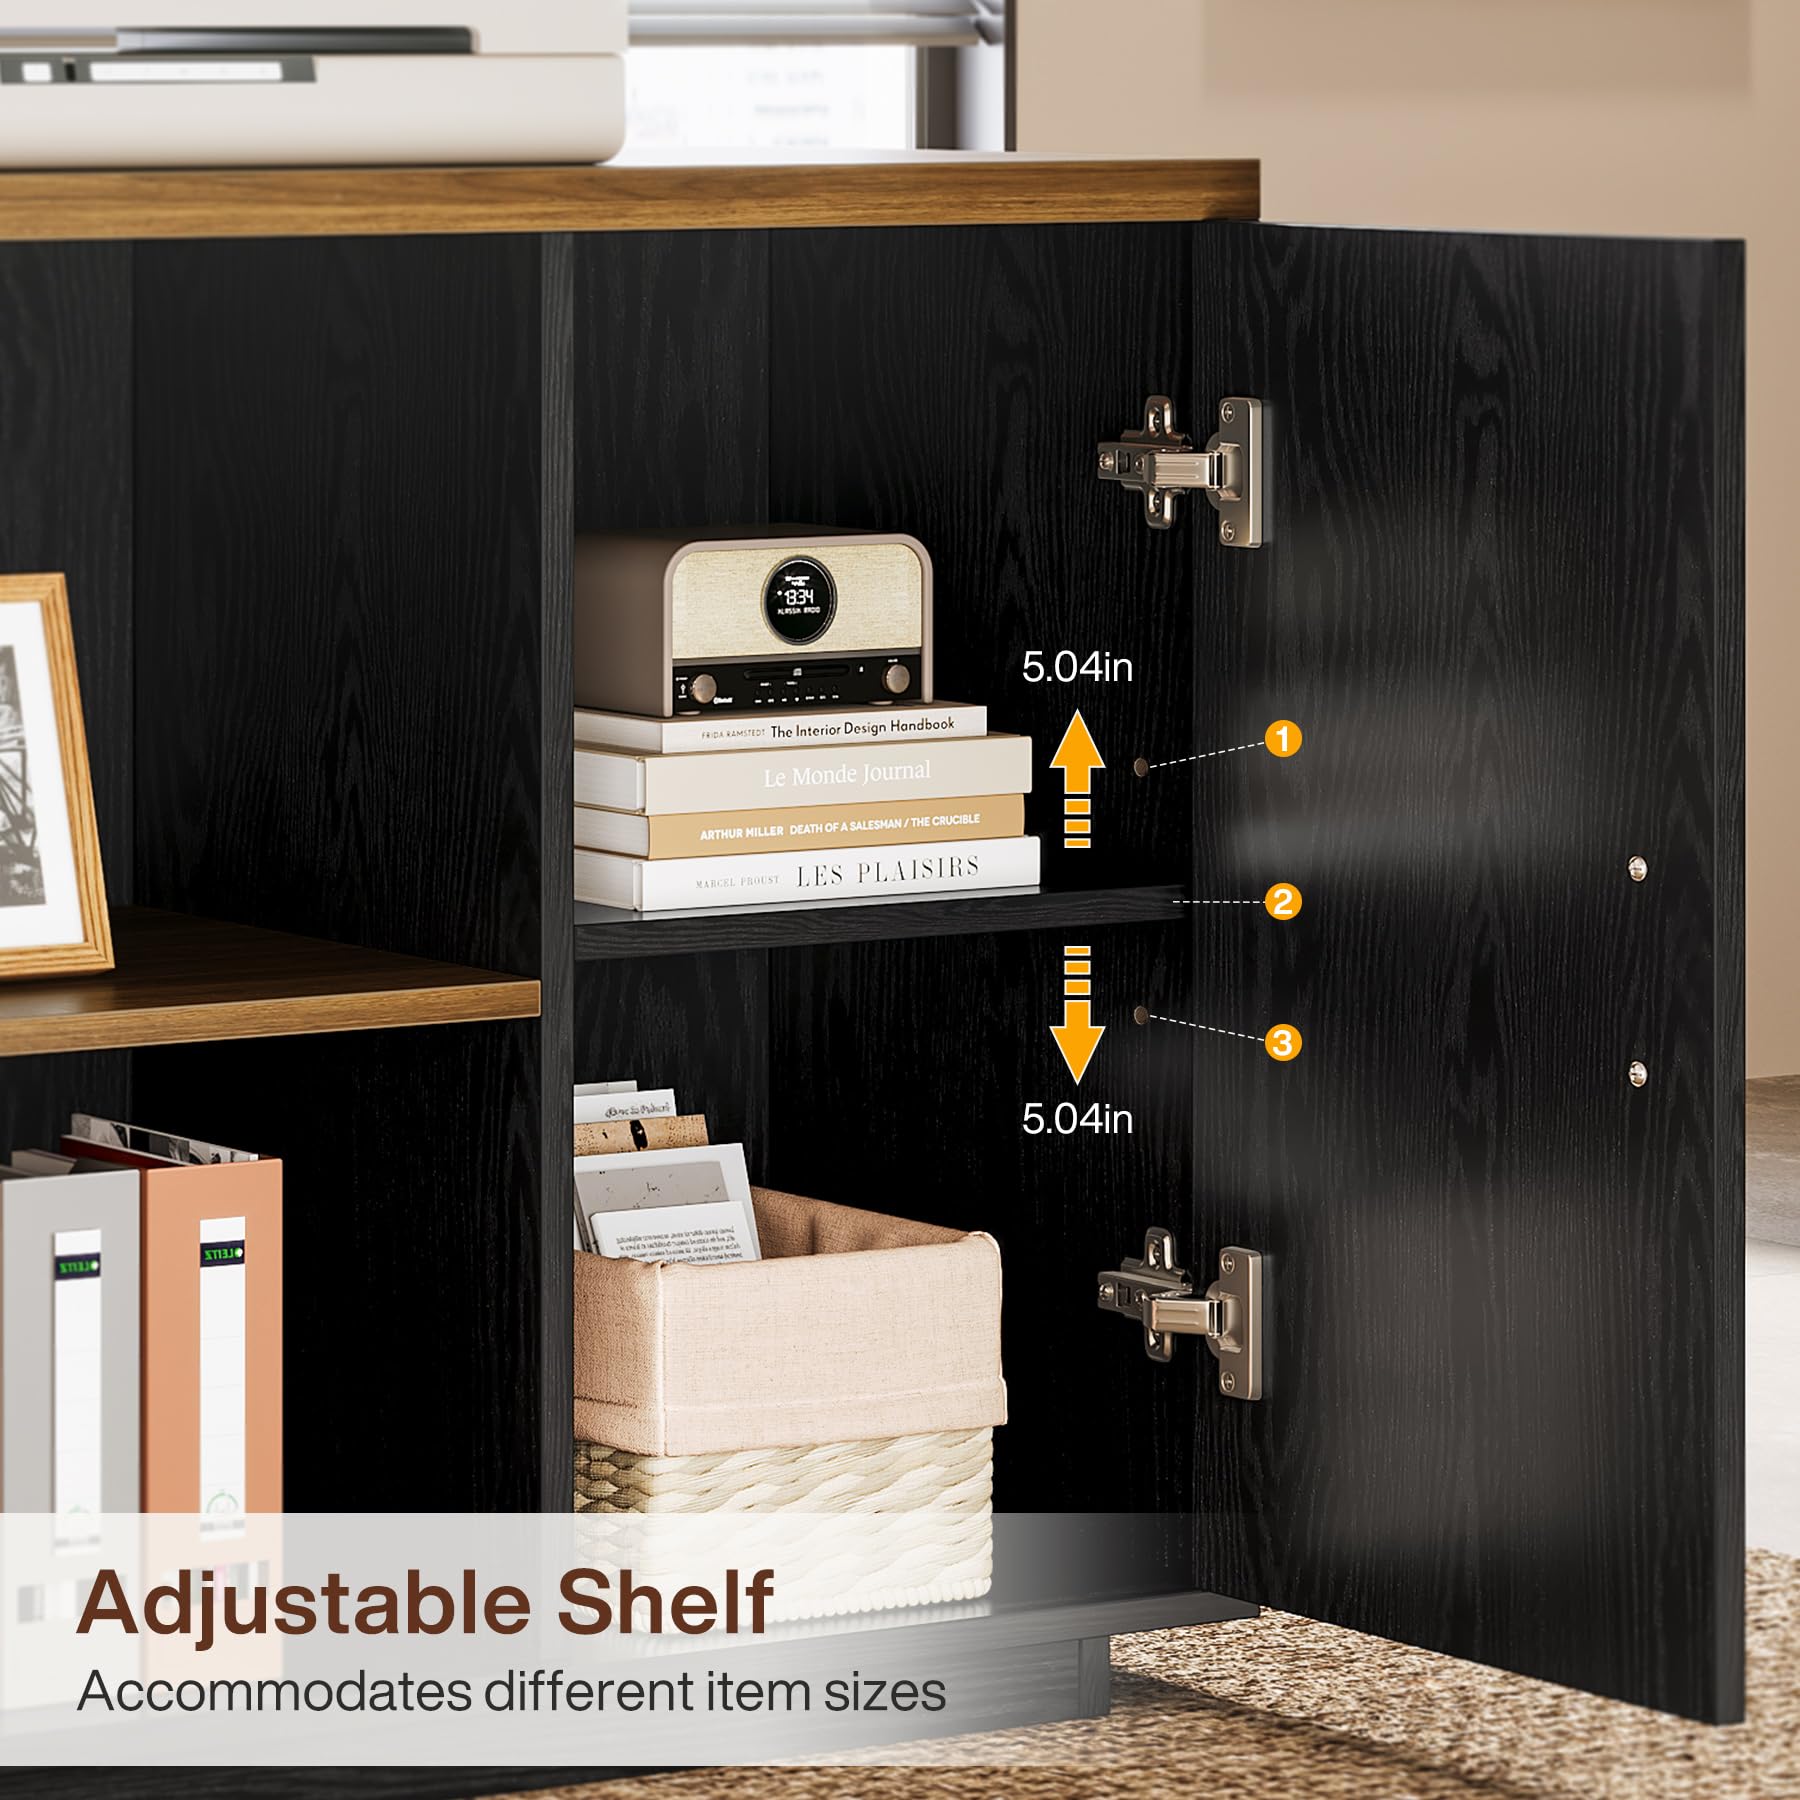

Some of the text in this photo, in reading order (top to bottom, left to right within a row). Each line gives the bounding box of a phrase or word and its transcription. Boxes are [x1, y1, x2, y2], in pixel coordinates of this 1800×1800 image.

[701, 716, 955, 740] FRIDA RAMSTEDT The Interior Design Handbook
[764, 760, 932, 788] Le Monde Journal
[700, 827, 743, 841] ARTHUR
[745, 825, 784, 839] MILLER
[790, 822, 823, 836] DEATH
[825, 821, 840, 833] OF
[840, 820, 848, 832] A
[850, 817, 902, 832] SALESMAN
[911, 815, 931, 828] THE
[932, 813, 981, 827] CRUCIBLE
[696, 854, 980, 890] MARCEL PROUST LES PLAISIRS
